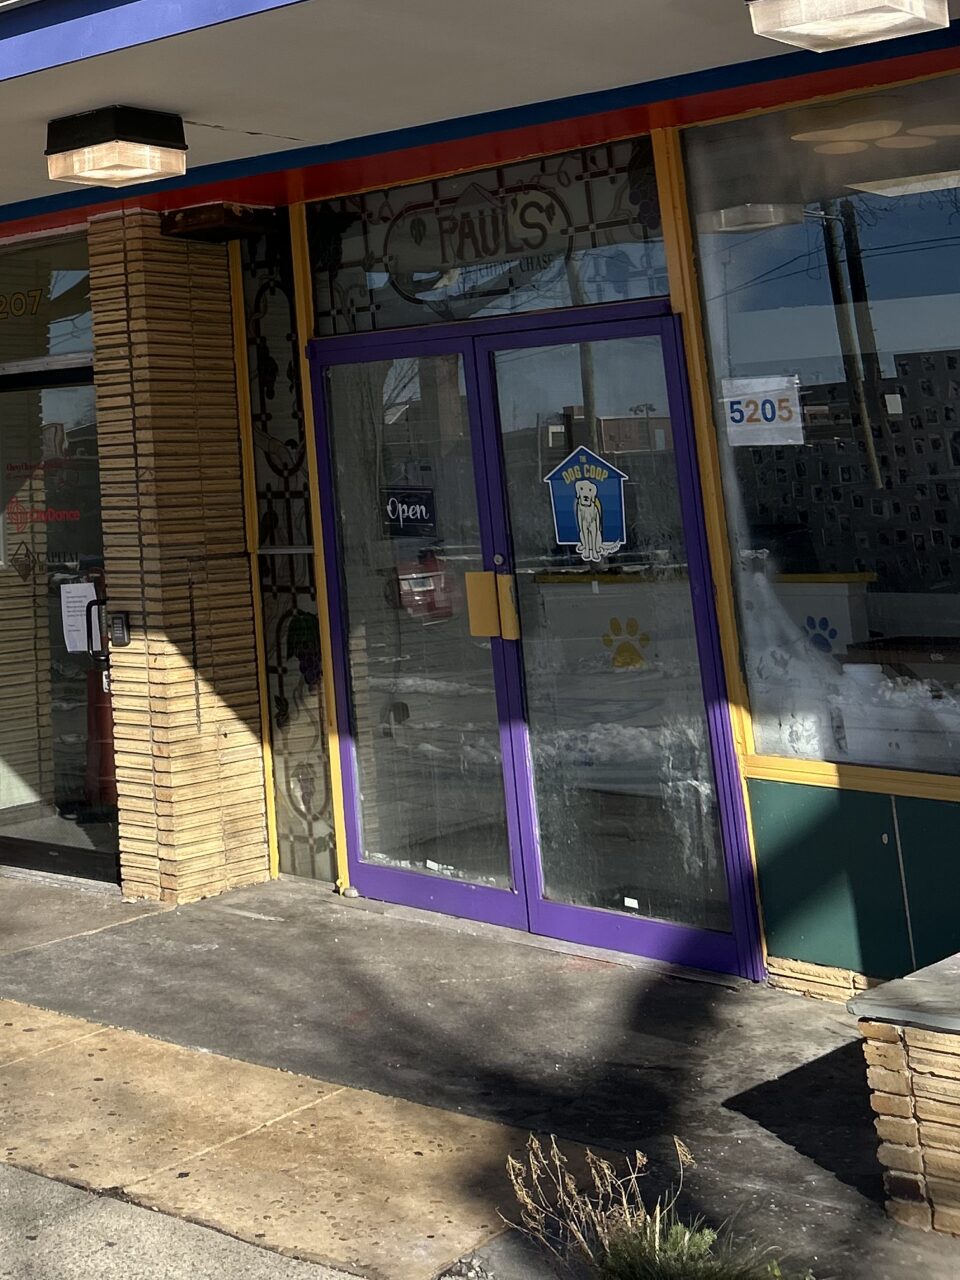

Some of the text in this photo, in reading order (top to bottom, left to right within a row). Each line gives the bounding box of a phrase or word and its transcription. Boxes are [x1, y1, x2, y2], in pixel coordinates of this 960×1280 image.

[436, 200, 548, 263] PAUL'S
[729, 398, 794, 424] 5205
[562, 464, 608, 484] DOG COOP
[387, 497, 429, 528] Open
